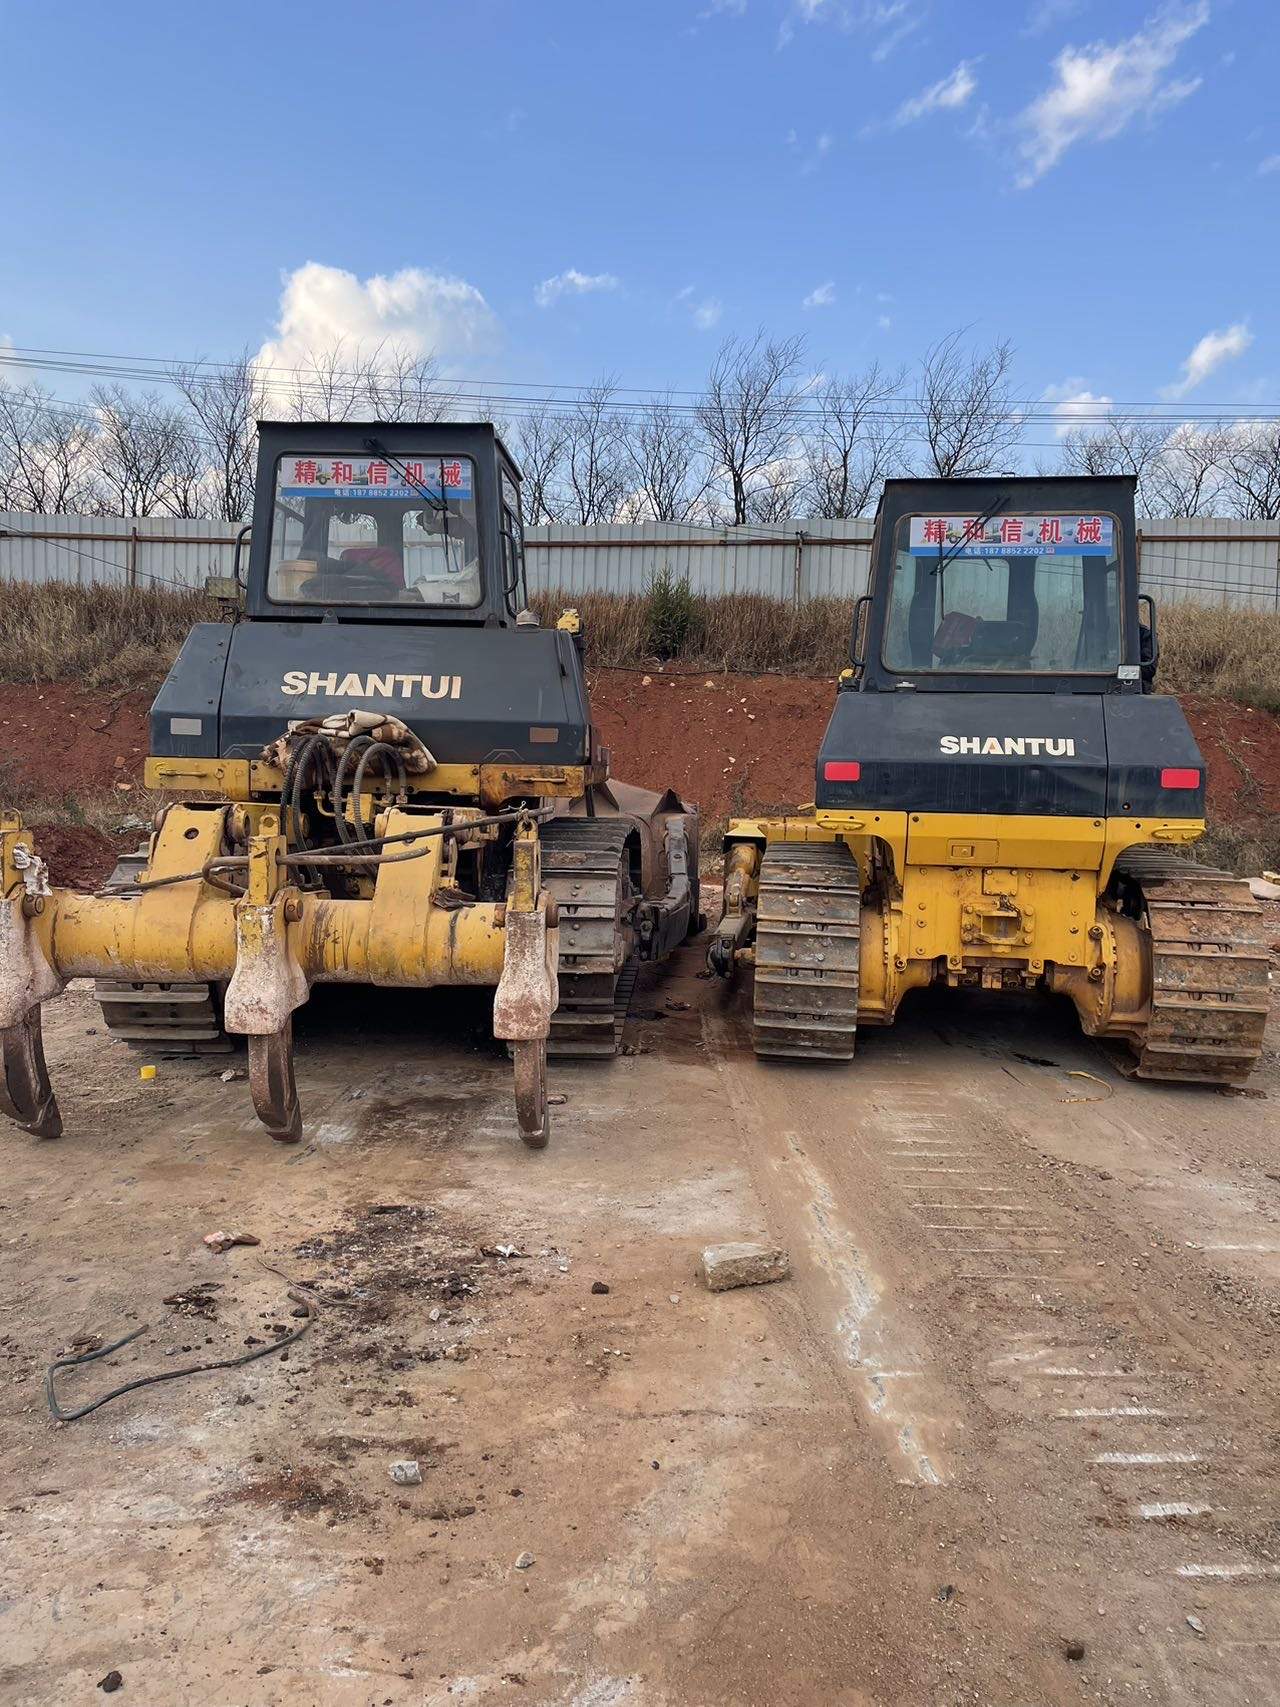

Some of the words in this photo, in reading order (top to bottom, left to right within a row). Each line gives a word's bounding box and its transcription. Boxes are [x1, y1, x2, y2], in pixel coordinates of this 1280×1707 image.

[294, 459, 463, 487] 精和信机械
[368, 489, 388, 497] 8852
[923, 518, 1102, 545] 精和信机械
[1001, 547, 1021, 555] 8852
[1023, 547, 1044, 555] 2202
[281, 671, 462, 699] SHANTUI
[940, 735, 1075, 756] SHANTUI
